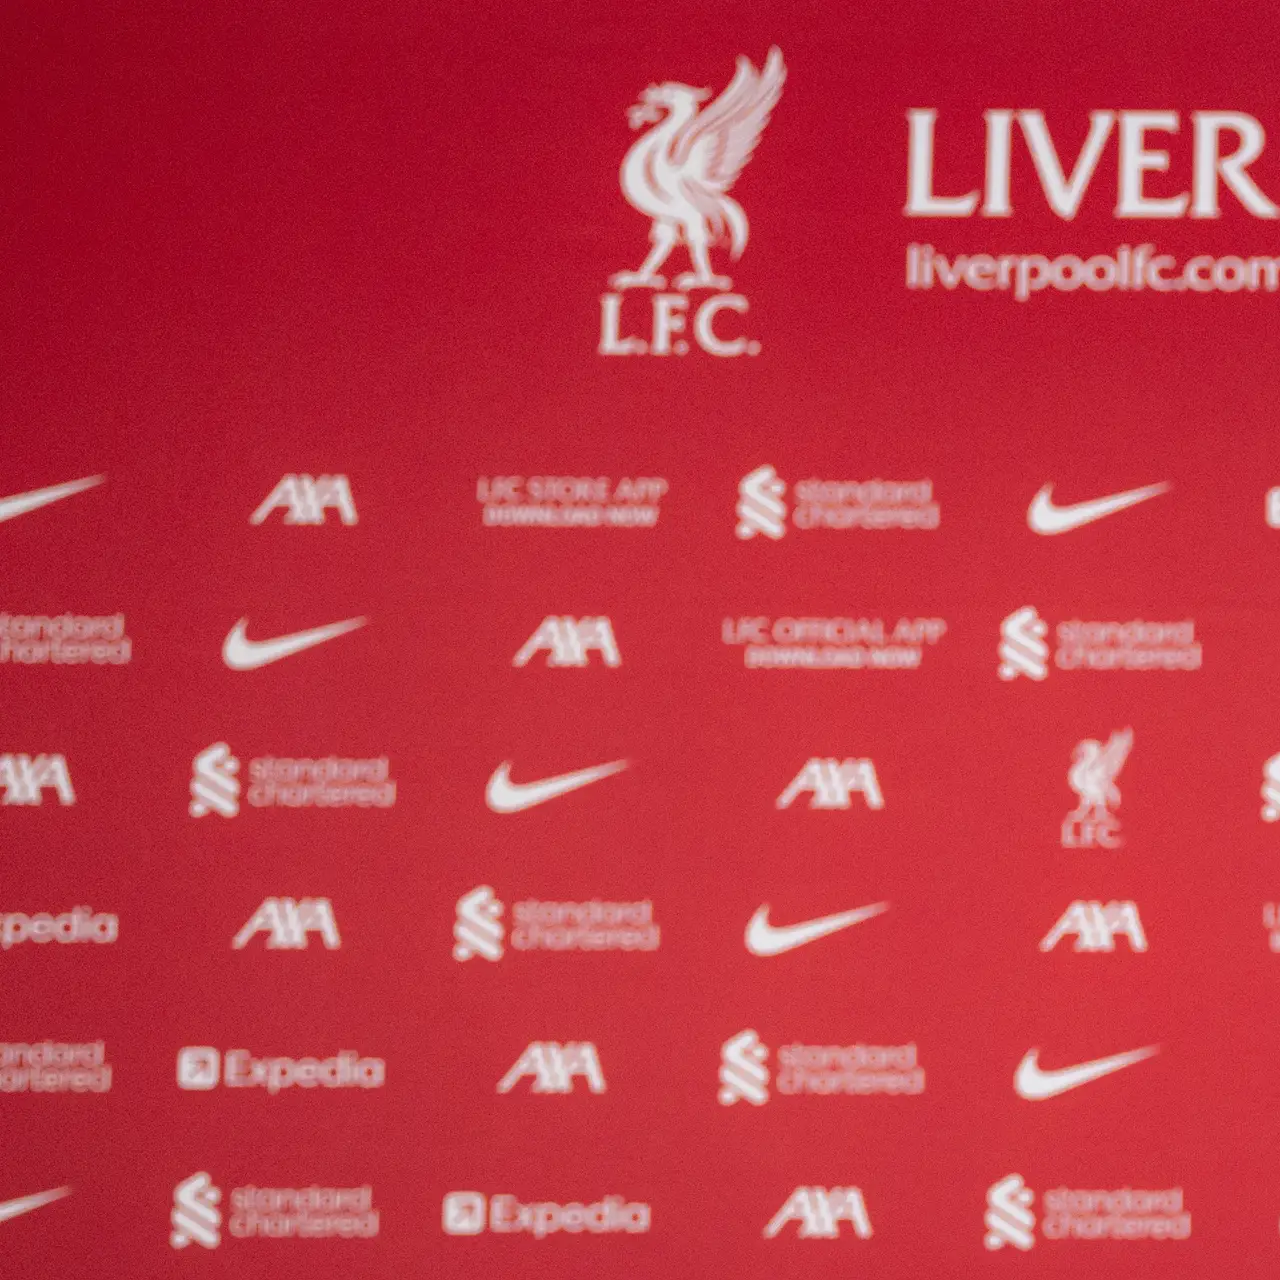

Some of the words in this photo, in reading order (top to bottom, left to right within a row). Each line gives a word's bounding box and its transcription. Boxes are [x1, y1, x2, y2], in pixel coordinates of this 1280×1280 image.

[252, 475, 357, 524] AXA
[515, 617, 620, 666] AXA
[778, 759, 883, 808] AXA
[234, 898, 340, 949] AXA
[1042, 901, 1146, 951] AXA
[221, 1050, 385, 1092] Expedia
[499, 1042, 605, 1093] AXA
[487, 1194, 651, 1237] Expedia
[765, 1187, 871, 1238] AXA
